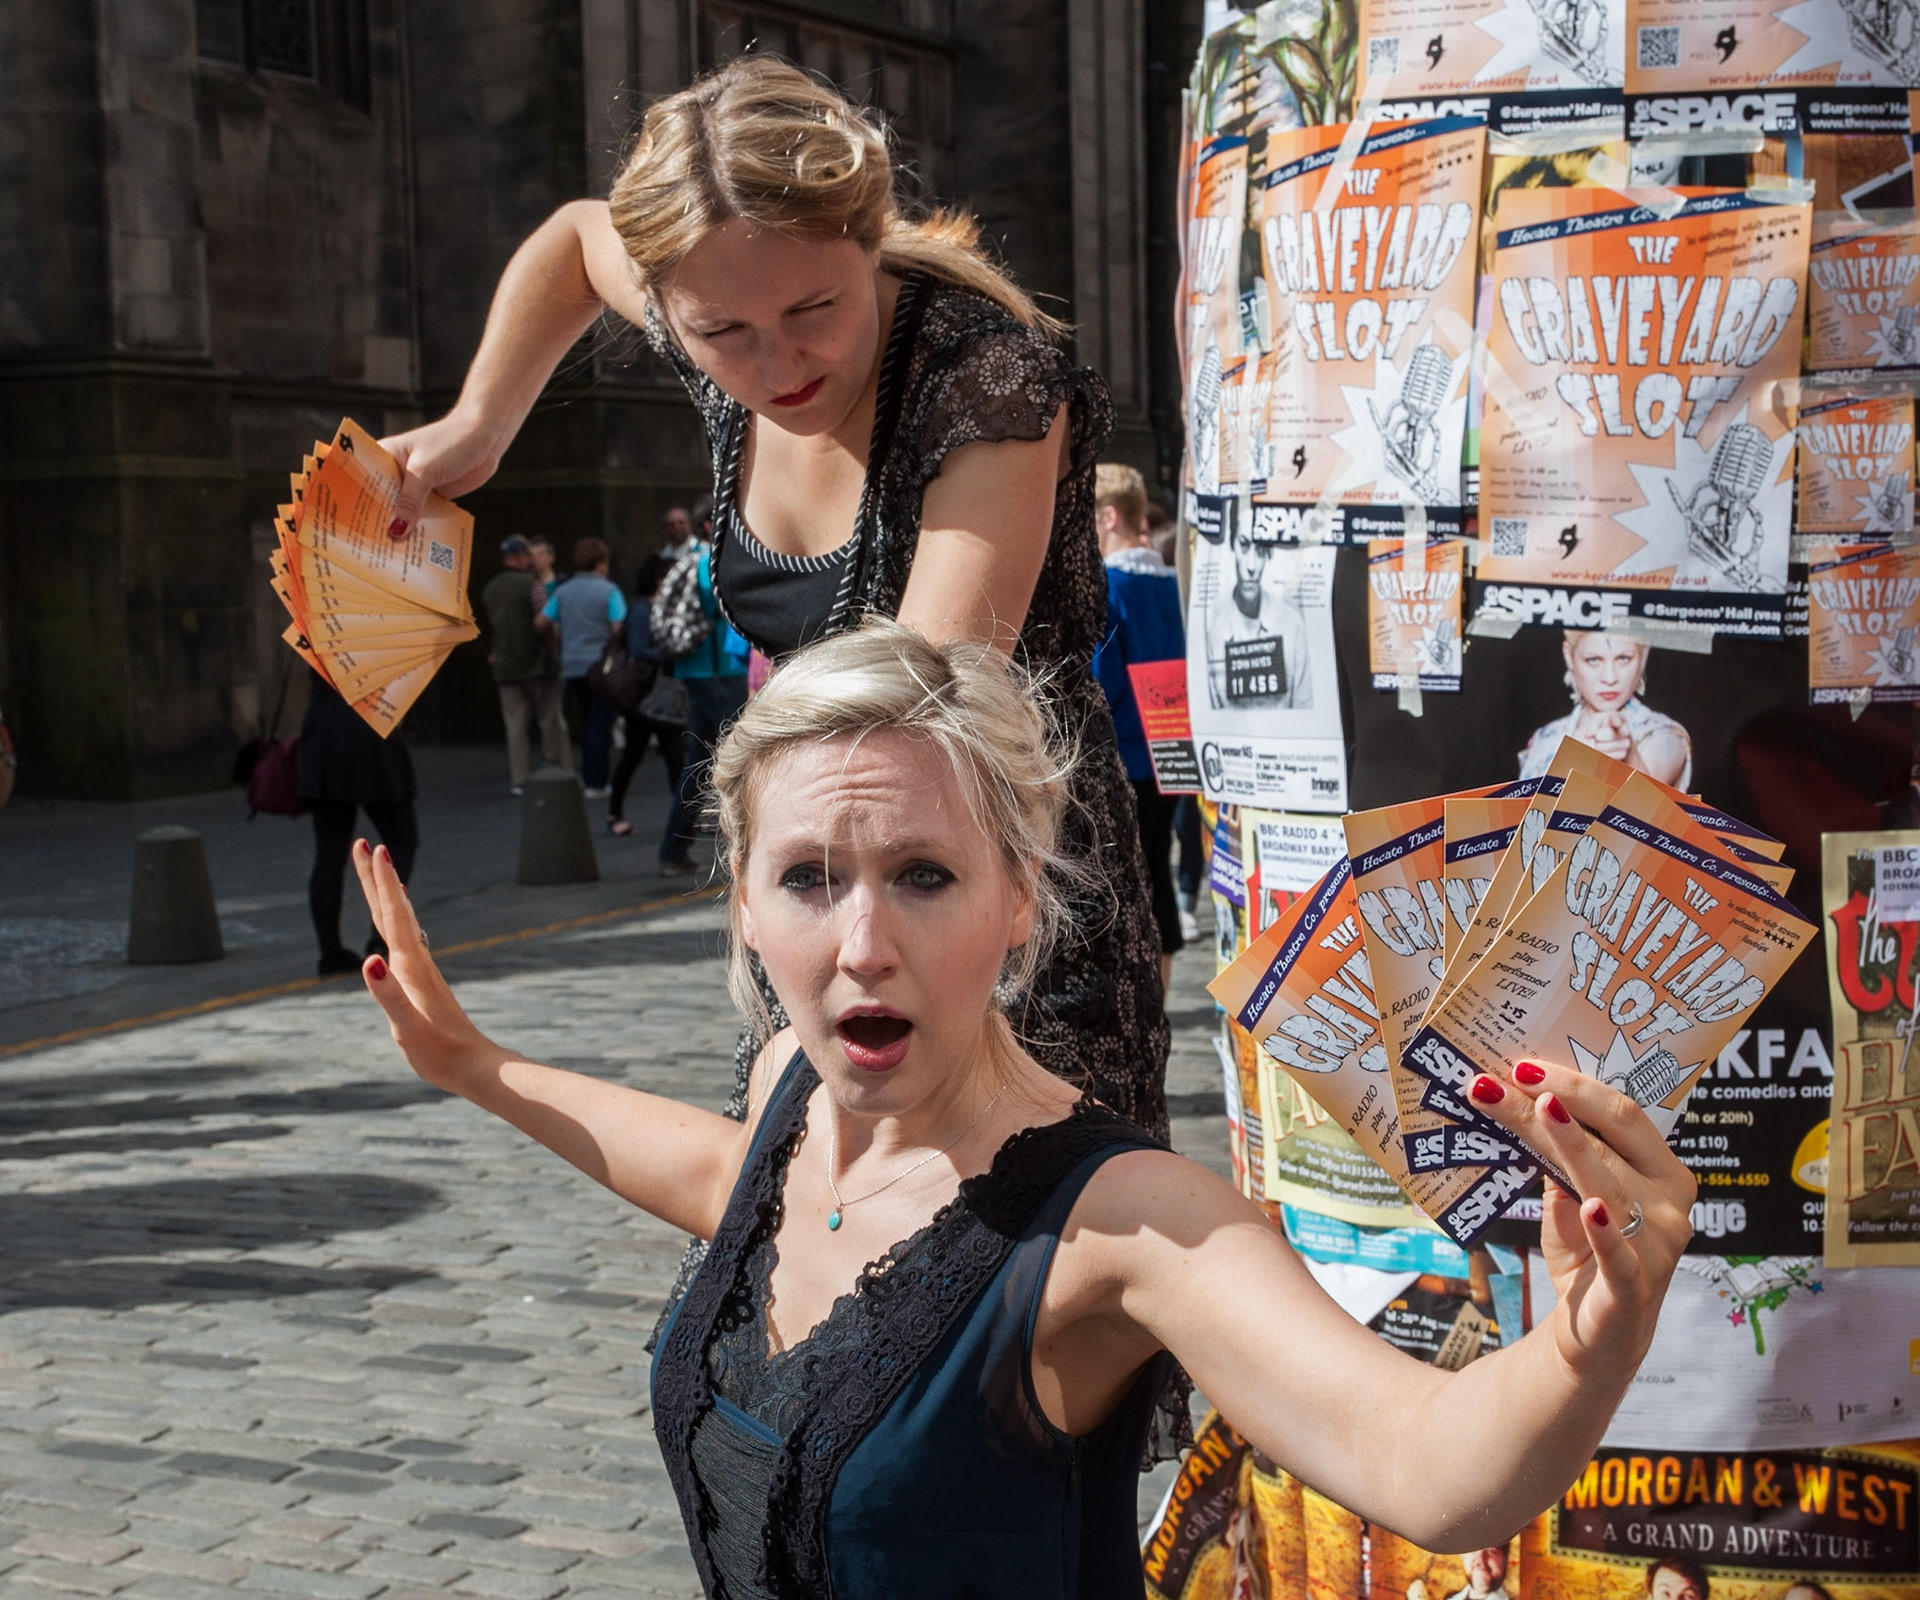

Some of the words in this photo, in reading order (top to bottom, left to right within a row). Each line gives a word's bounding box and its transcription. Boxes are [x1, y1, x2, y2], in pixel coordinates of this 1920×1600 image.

[1574, 102, 1601, 116] Hall
[1650, 93, 1797, 133] SPACE
[1302, 149, 1339, 171] Theatr
[1344, 168, 1382, 195] THE
[1509, 225, 1559, 246] Hecate
[1566, 215, 1624, 234] Theatre
[1630, 206, 1655, 223] Co.
[1264, 201, 1473, 297] GRAVEYARD
[1627, 236, 1680, 265] THE
[1810, 255, 1920, 291] GRAVEYARD
[1836, 290, 1901, 315] SLOT
[1293, 298, 1431, 362] SLOT
[1500, 275, 1798, 368] GRAVEYARD
[1556, 372, 1744, 439] SLOT
[1799, 423, 1913, 456] GRAVEYARD
[1826, 457, 1894, 481] SLOT
[1262, 506, 1345, 541] SPACE
[1497, 587, 1633, 627] SPACE
[1809, 577, 1920, 612] GRAVEYARD
[1390, 603, 1443, 626] SLOT
[1644, 603, 1724, 618] @Surgeons'
[1725, 607, 1753, 620] Hall
[1835, 612, 1905, 636] SLOT
[1784, 625, 1810, 636] Gua
[1249, 674, 1279, 694] 456
[1311, 778, 1340, 793] fringe
[1260, 824, 1280, 837] BBC
[1283, 826, 1318, 840] RADIO
[1321, 829, 1329, 839] 4
[1558, 817, 1591, 831] Heca
[1262, 840, 1309, 853] BROADWAY
[1311, 844, 1338, 856] BABY
[1362, 846, 1403, 872] Hecate
[1408, 824, 1445, 849] Theat
[1455, 838, 1500, 858] Hecate
[1607, 814, 1651, 841] Hecate
[1653, 834, 1699, 863] Theatre
[1701, 857, 1718, 873] Co.
[1718, 869, 1778, 901] presents...
[1882, 849, 1918, 863] BBC
[1683, 876, 1721, 916] THE
[1319, 914, 1360, 953] THE
[1505, 928, 1514, 938] a
[1515, 931, 1560, 954] RADIO
[1565, 834, 1766, 1024] GRAVEYARD
[1246, 980, 1277, 1022] Hecate
[1273, 932, 1307, 979] Theatre
[1304, 912, 1320, 932] Co.
[1511, 951, 1540, 967] play
[1491, 960, 1552, 988] performed
[1495, 977, 1540, 1000] LIVE!!
[1569, 931, 1695, 1044] SLOT
[1381, 1011, 1388, 1020] a
[1391, 987, 1431, 1015] RADIO
[1463, 983, 1482, 998] Show
[1481, 996, 1499, 1012] Time:
[1514, 1025, 1527, 1036] pm
[1443, 1008, 1471, 1035] theSpace
[1478, 1036, 1505, 1061] Surgeons
[1471, 1017, 1495, 1038] Theatre
[1492, 1020, 1506, 1034] Aug
[1411, 1037, 1440, 1063] the
[1701, 1028, 1835, 1079] KFA
[1352, 1085, 1379, 1126] RADIO
[1429, 1089, 1450, 1110] th
[1712, 1085, 1797, 1100] comedies
[1800, 1084, 1834, 1098] and
[1370, 1105, 1388, 1134] play
[1702, 1113, 1717, 1124] or
[1719, 1111, 1755, 1127] 20th)
[1379, 1116, 1400, 1155] perfor
[1451, 1130, 1468, 1161] the
[1699, 1136, 1729, 1151] £10)
[1414, 1137, 1430, 1169] the
[1696, 1173, 1770, 1187] 1-556-6550
[1688, 1201, 1747, 1238] nge
[1802, 1201, 1825, 1215] QU
[1448, 1212, 1475, 1242] the
[1848, 1221, 1887, 1233] Follow
[1889, 1221, 1909, 1232] the
[1144, 1428, 1232, 1585] MORGAN
[1564, 1457, 1743, 1511] MORGAN
[1752, 1458, 1784, 1509] &
[1793, 1461, 1913, 1531] WEST
[1184, 1485, 1235, 1542] GRAND
[1601, 1523, 1619, 1541] A
[1626, 1522, 1715, 1553] GRAND
[1723, 1524, 1877, 1560] ADVENTURE
